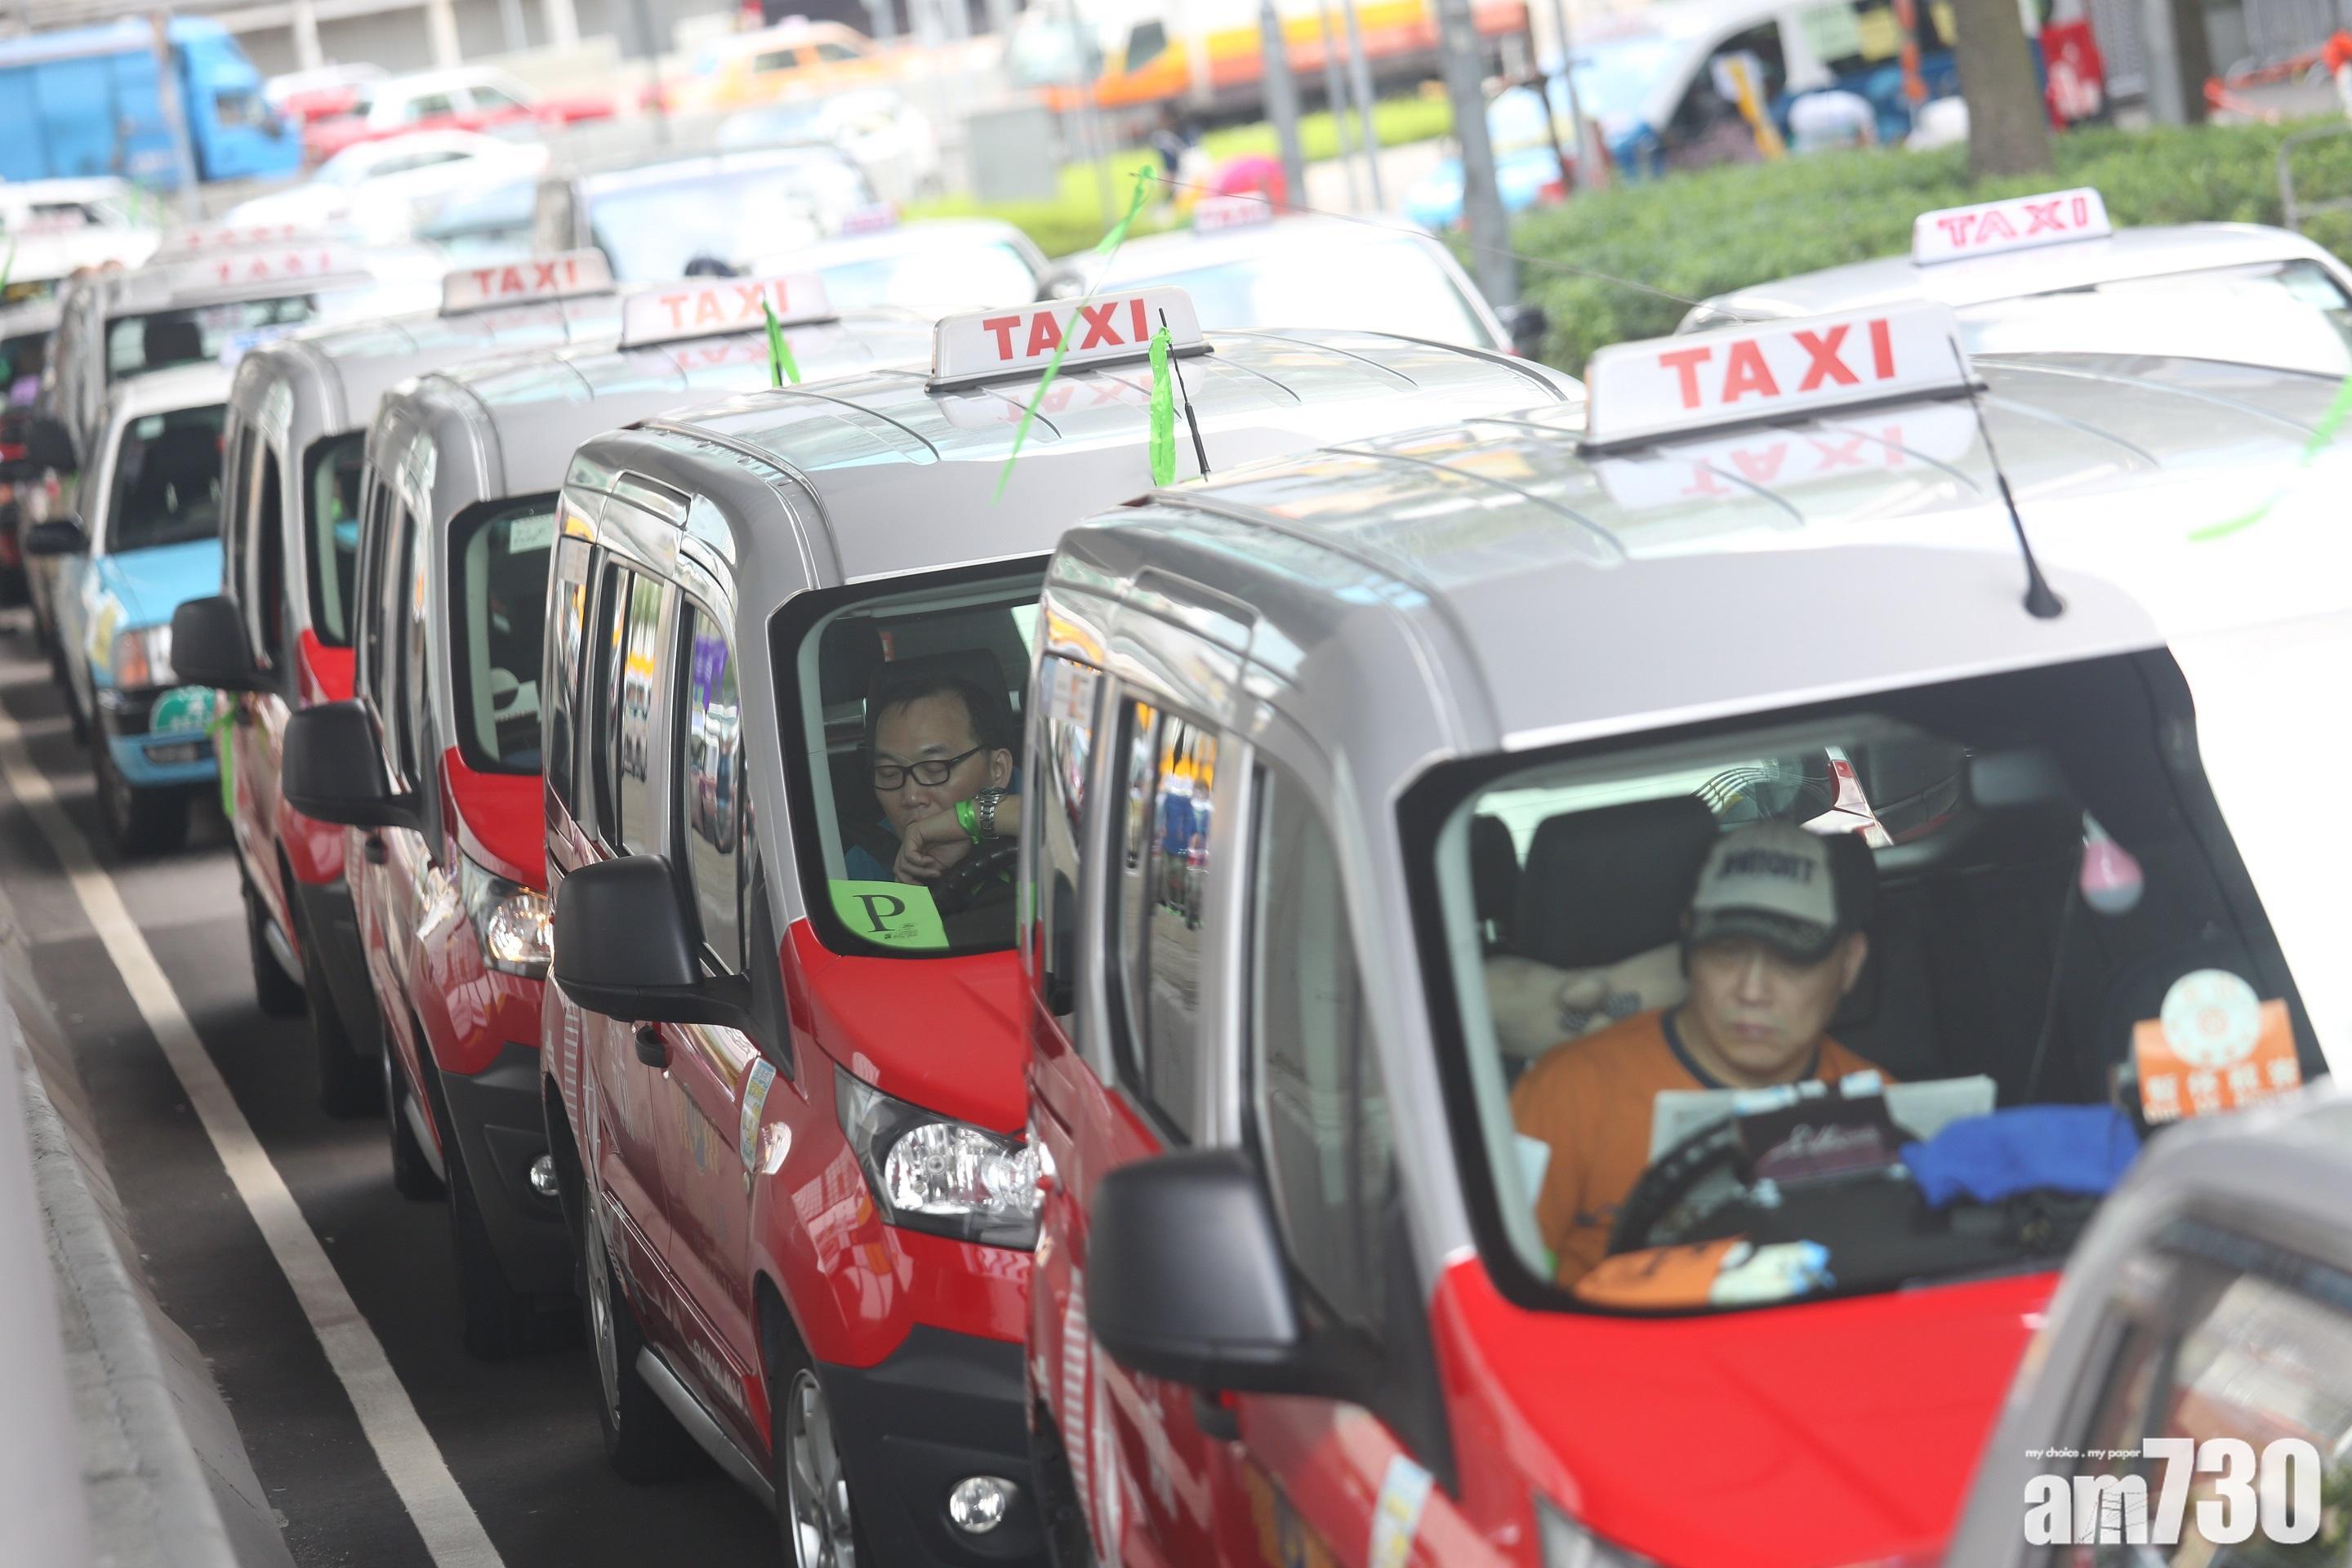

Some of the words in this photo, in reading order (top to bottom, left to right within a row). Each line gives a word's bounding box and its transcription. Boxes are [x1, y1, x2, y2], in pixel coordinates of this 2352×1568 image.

[1937, 196, 2089, 247] TAXI
[471, 259, 577, 295] TAXI
[660, 279, 790, 330] TAXI
[982, 298, 1149, 360] TAXI
[1658, 318, 1896, 409] TAXI
[852, 894, 906, 933] P
